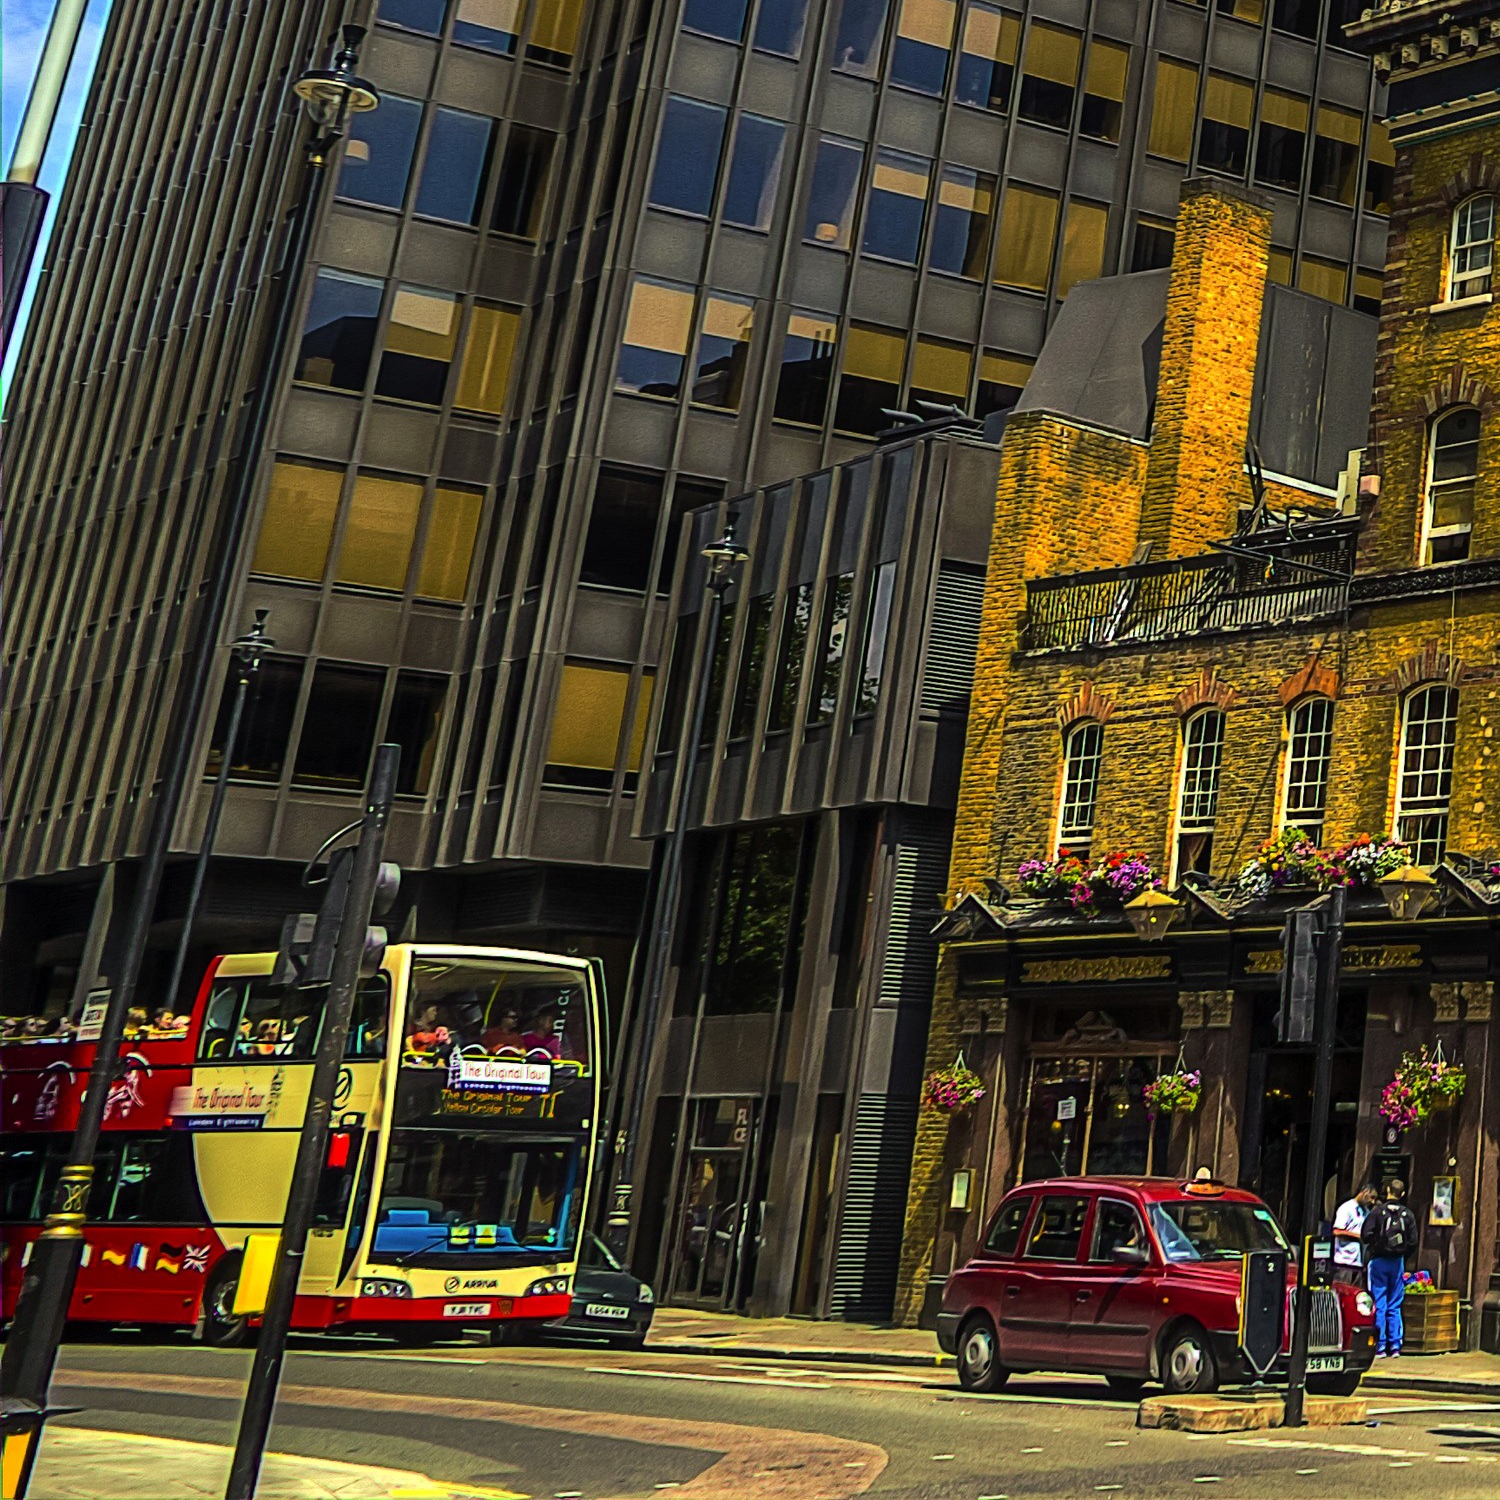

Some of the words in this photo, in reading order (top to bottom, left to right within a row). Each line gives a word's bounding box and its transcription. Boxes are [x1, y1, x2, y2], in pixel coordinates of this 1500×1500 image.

[464, 1063, 480, 1077] The
[484, 1063, 522, 1080] Original
[525, 1065, 547, 1080] Tour
[193, 1087, 207, 1108] The
[209, 1087, 244, 1112] Original
[244, 1085, 265, 1108] Tour
[463, 1279, 498, 1289] ARRIVA
